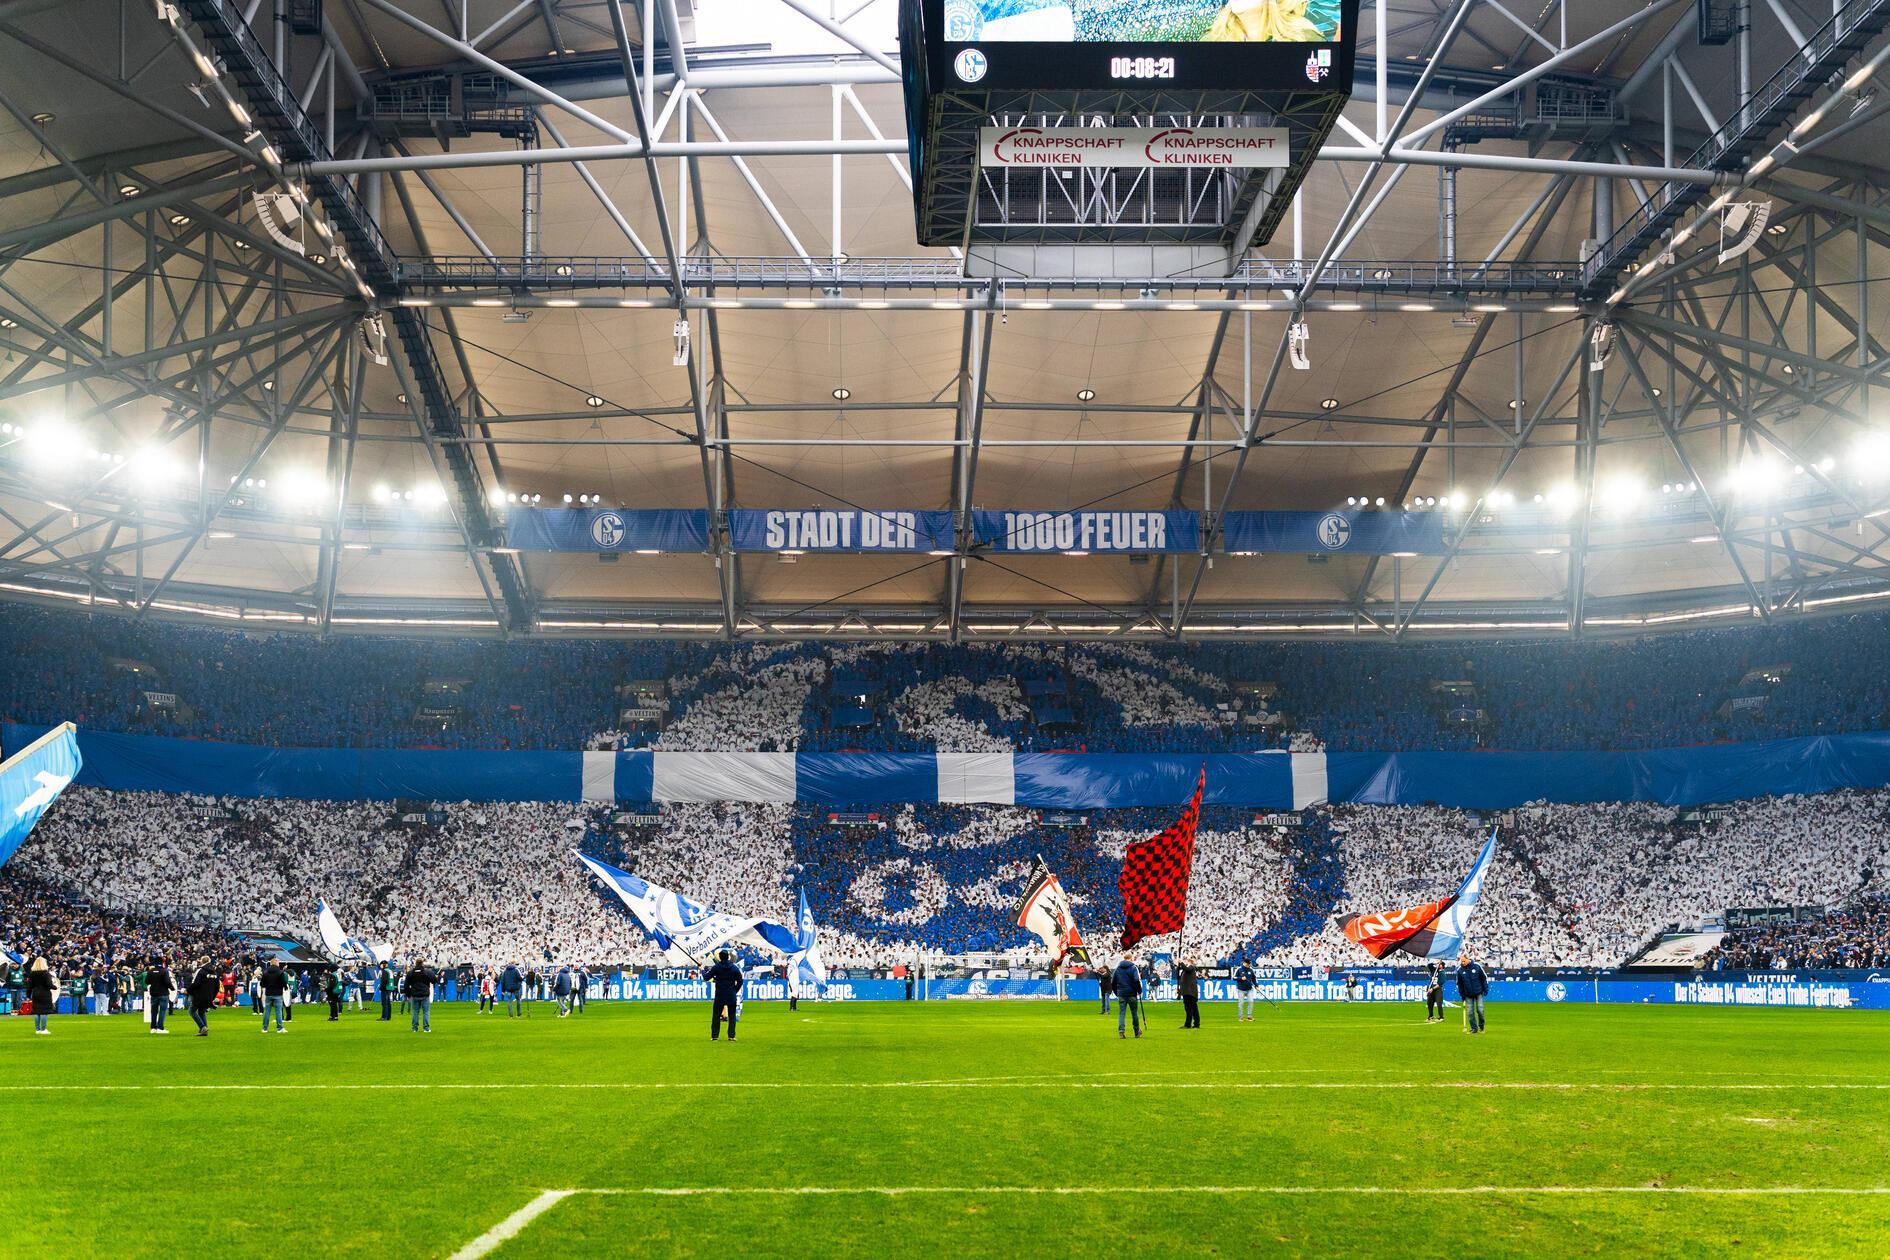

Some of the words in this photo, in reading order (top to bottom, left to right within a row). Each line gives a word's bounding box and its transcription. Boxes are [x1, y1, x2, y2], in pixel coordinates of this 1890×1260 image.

[1013, 137, 1125, 148] KNAPPSCHAFT
[1164, 138, 1276, 149] KNAPPSCHAFT
[1013, 153, 1082, 164] KLINIKEN
[1164, 153, 1233, 164] KLINIKEN
[766, 511, 856, 548] STADT
[861, 512, 915, 548] DER
[1005, 513, 1074, 550] 1000
[1082, 513, 1166, 549] FEUER
[1266, 816, 1298, 824] VELTINS
[686, 930, 718, 956] Verband
[623, 980, 642, 1000] 04
[645, 979, 708, 1000] wünscht
[747, 980, 784, 1000] frohe
[1204, 980, 1224, 1000] 04
[1226, 980, 1289, 1000] wscht
[1290, 980, 1324, 1000] Euch
